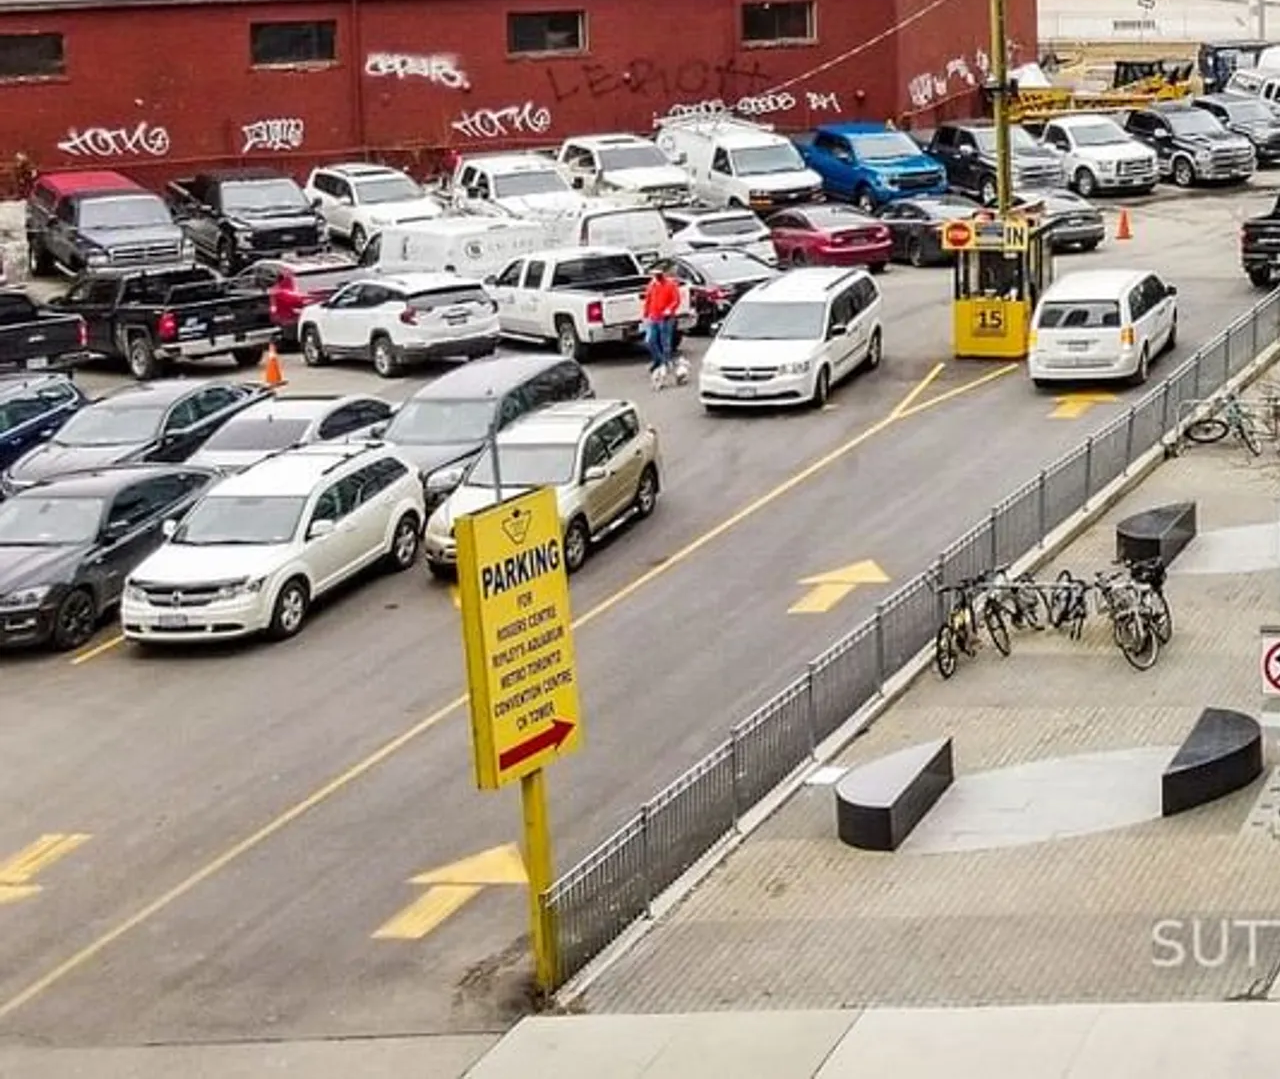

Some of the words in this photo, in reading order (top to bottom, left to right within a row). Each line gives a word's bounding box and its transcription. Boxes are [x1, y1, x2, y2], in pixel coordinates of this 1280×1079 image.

[1006, 226, 1025, 247] IN
[978, 310, 1002, 329] 15
[481, 538, 560, 600] PARKING
